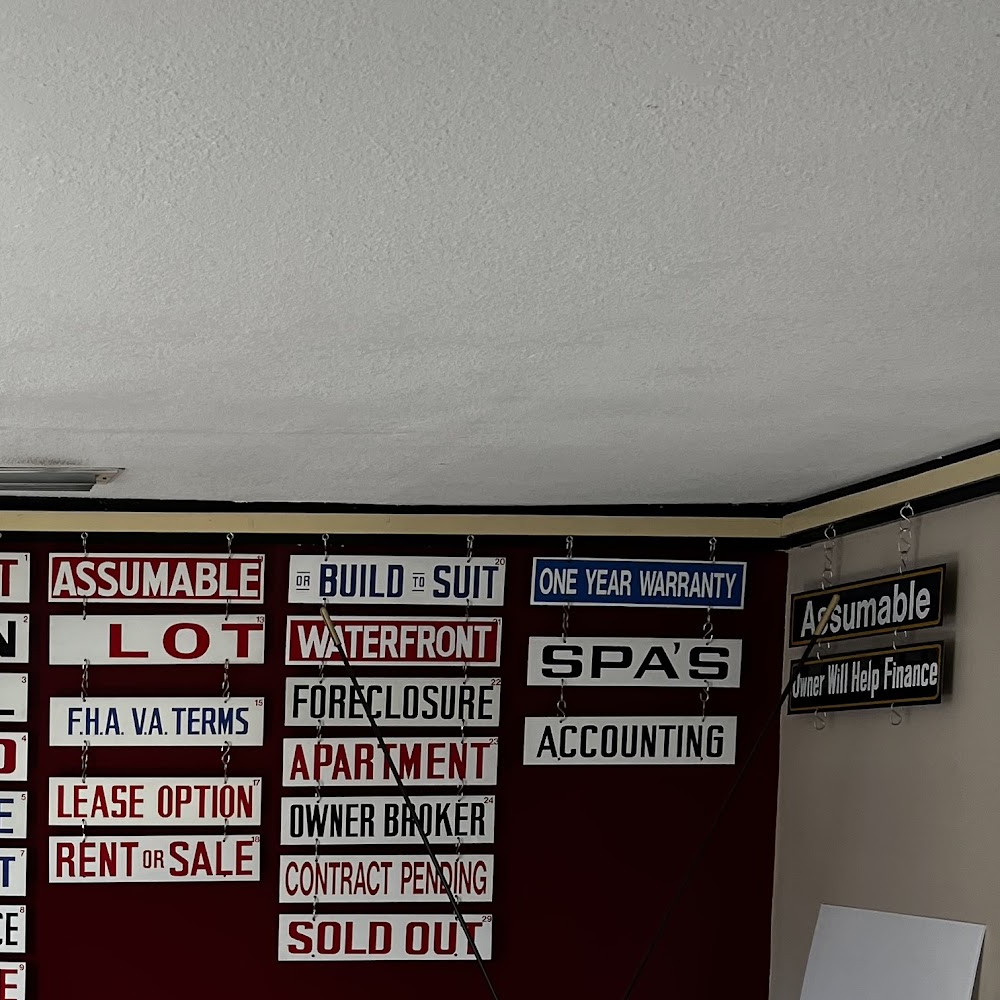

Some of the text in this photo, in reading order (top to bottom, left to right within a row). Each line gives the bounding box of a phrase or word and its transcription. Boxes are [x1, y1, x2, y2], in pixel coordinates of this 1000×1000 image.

[53, 562, 259, 597] ASSUMABLE
[296, 564, 498, 598] OR BUILD TO SUIT
[540, 568, 736, 599] ONE YEAR WARRANTY
[801, 580, 930, 637] Assumable
[109, 623, 263, 659] LOT
[297, 625, 491, 658] WATERFRONT
[541, 642, 729, 680] SPA'S
[792, 657, 938, 699] Owner Will Help Finance
[293, 685, 493, 720] FORECLOSURE
[68, 708, 248, 735] F.H.A. V.A. TERMS
[536, 725, 724, 759] ACCOUNTING
[290, 742, 490, 780] APARTMENT
[58, 786, 253, 818] LEASE OPTION
[290, 803, 485, 837] OWNER BROKER
[56, 841, 253, 877] RENT OR SALE
[286, 861, 487, 896] CONTRACT PENDING
[288, 921, 482, 955] SOLD OUT
